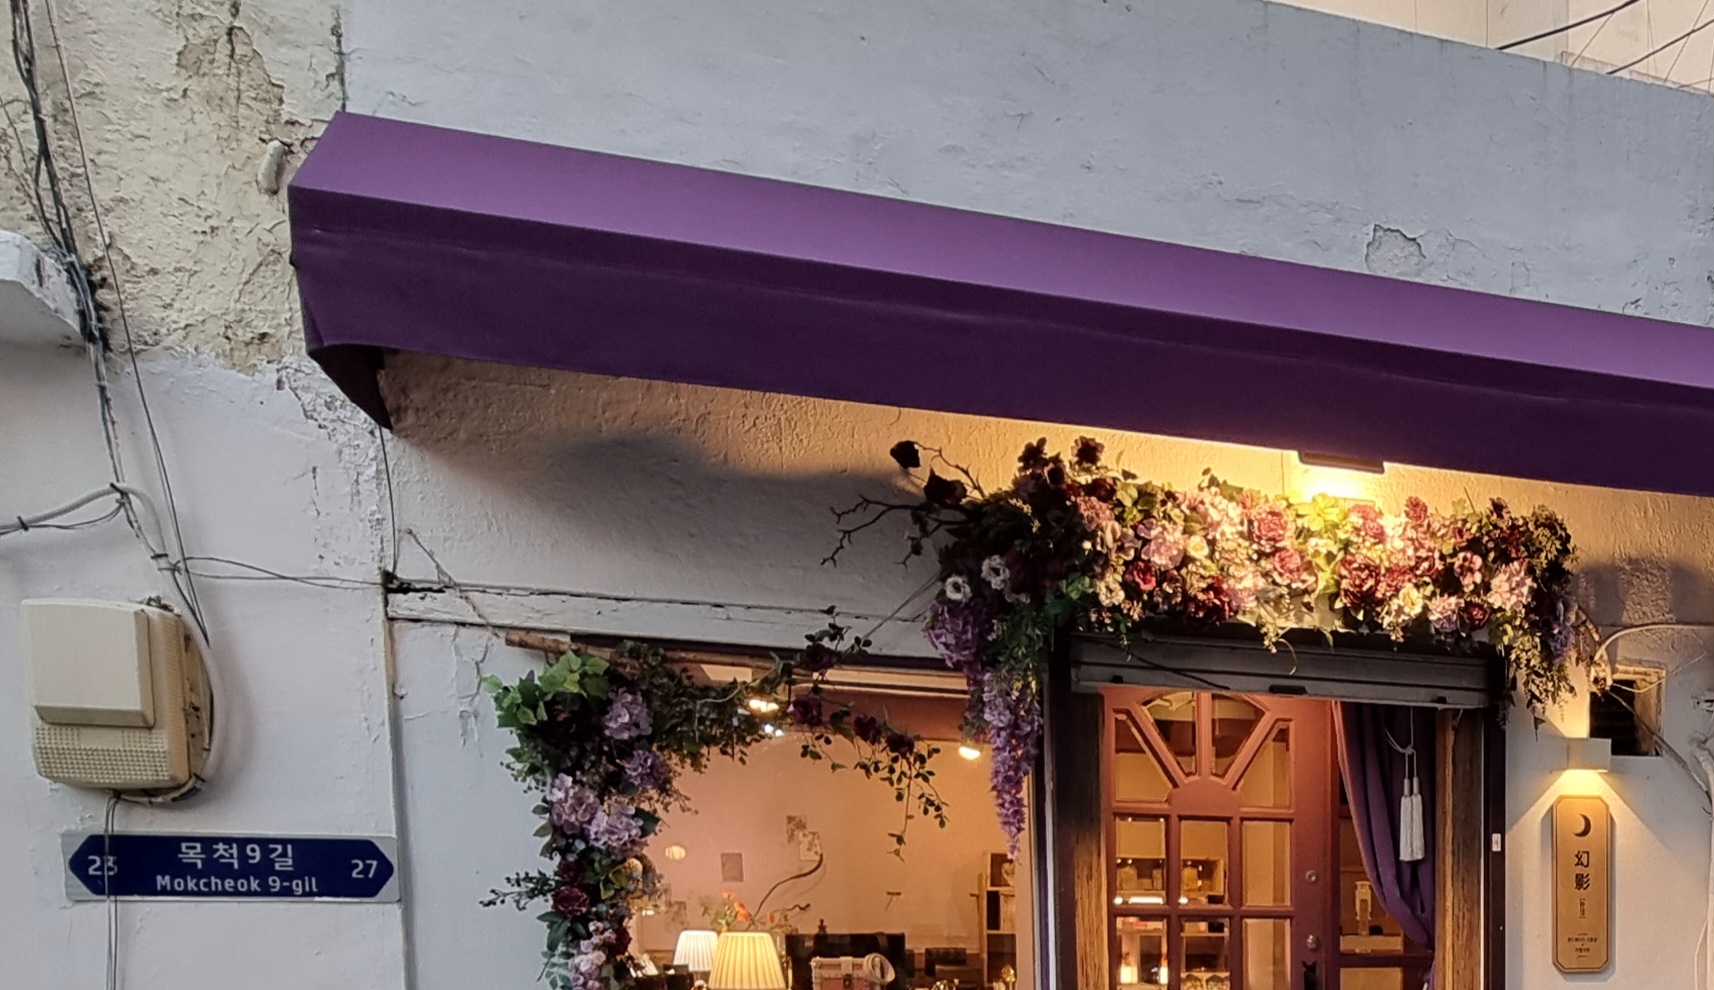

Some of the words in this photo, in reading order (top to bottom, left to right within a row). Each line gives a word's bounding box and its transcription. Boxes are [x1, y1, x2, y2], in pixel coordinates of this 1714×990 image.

[177, 841, 295, 872] 목척9길
[350, 859, 379, 879] 27
[1573, 849, 1591, 891] 幻影
[156, 874, 262, 892] Mokcheok
[268, 876, 319, 896] 9-gil
